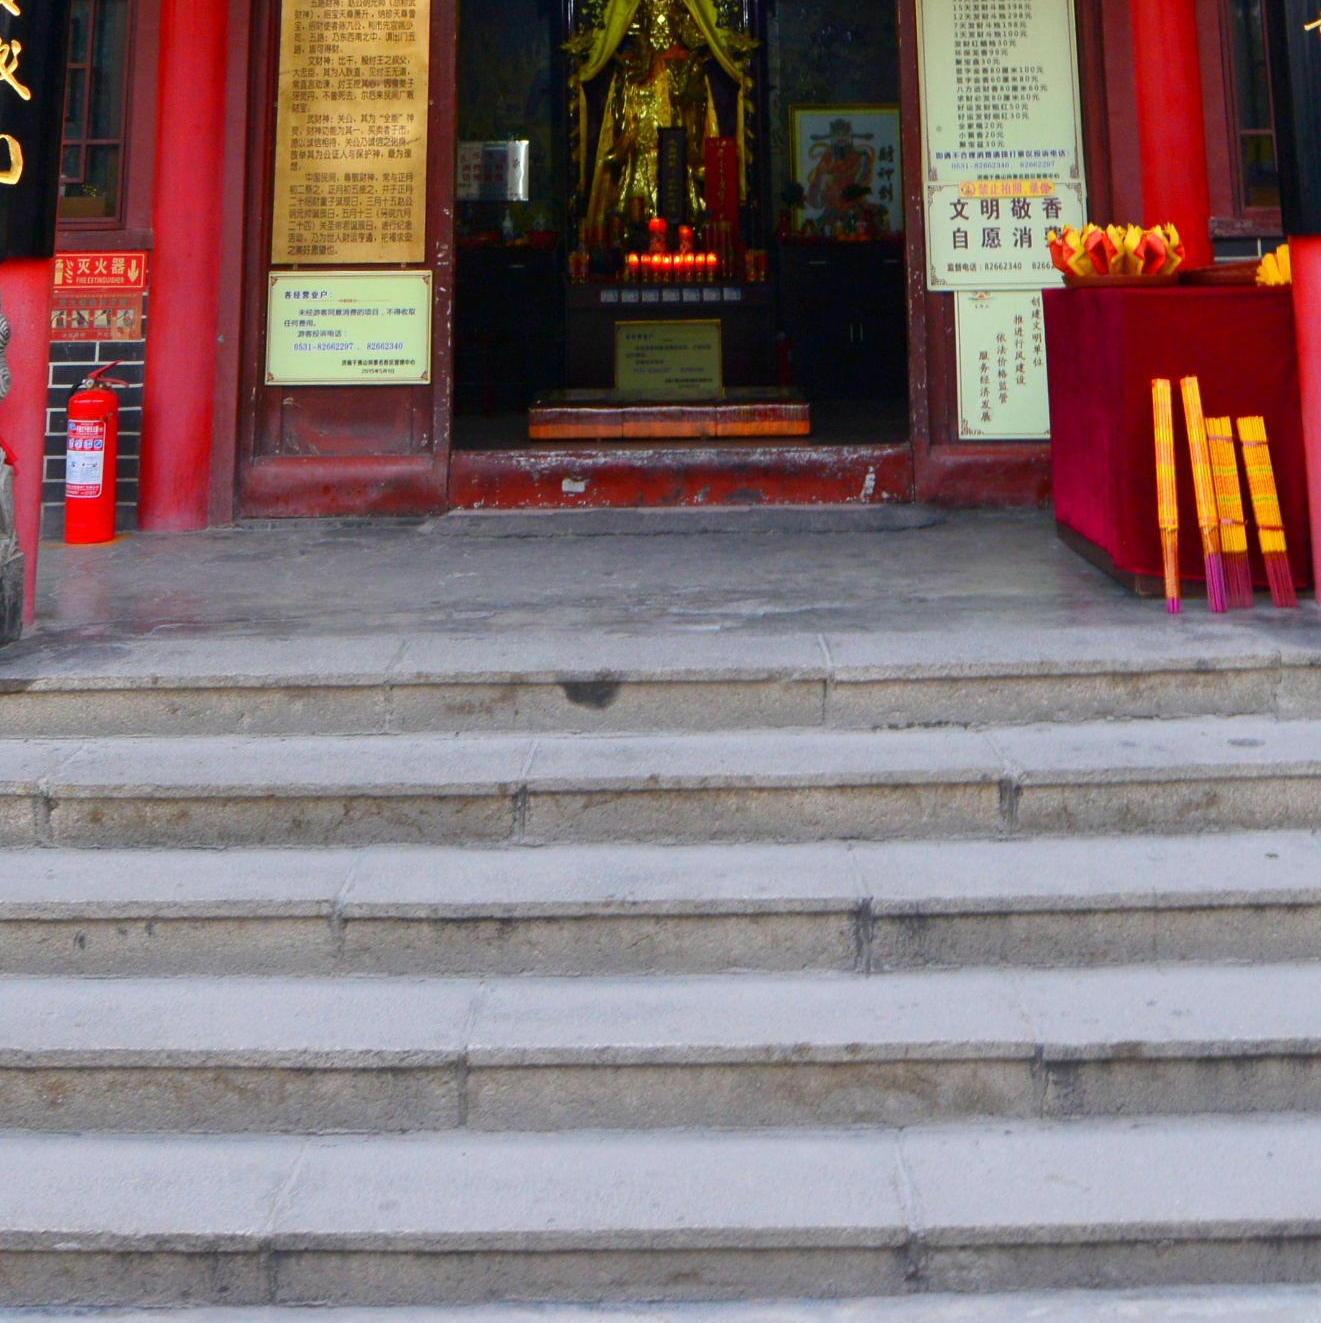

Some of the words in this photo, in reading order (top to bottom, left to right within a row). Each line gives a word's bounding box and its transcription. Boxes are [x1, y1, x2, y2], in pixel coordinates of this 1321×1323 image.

[950, 197, 1062, 221] 文明敬香
[979, 183, 1051, 195] 禁止拍照、录像
[77, 258, 125, 274] 灭火器
[367, 342, 403, 350] 82662340
[1014, 314, 1026, 385] 推进行风建设
[1031, 296, 1043, 367] 创建文明单位
[979, 351, 991, 422] 服务经济发展
[996, 333, 1007, 404] 依法价格监管
